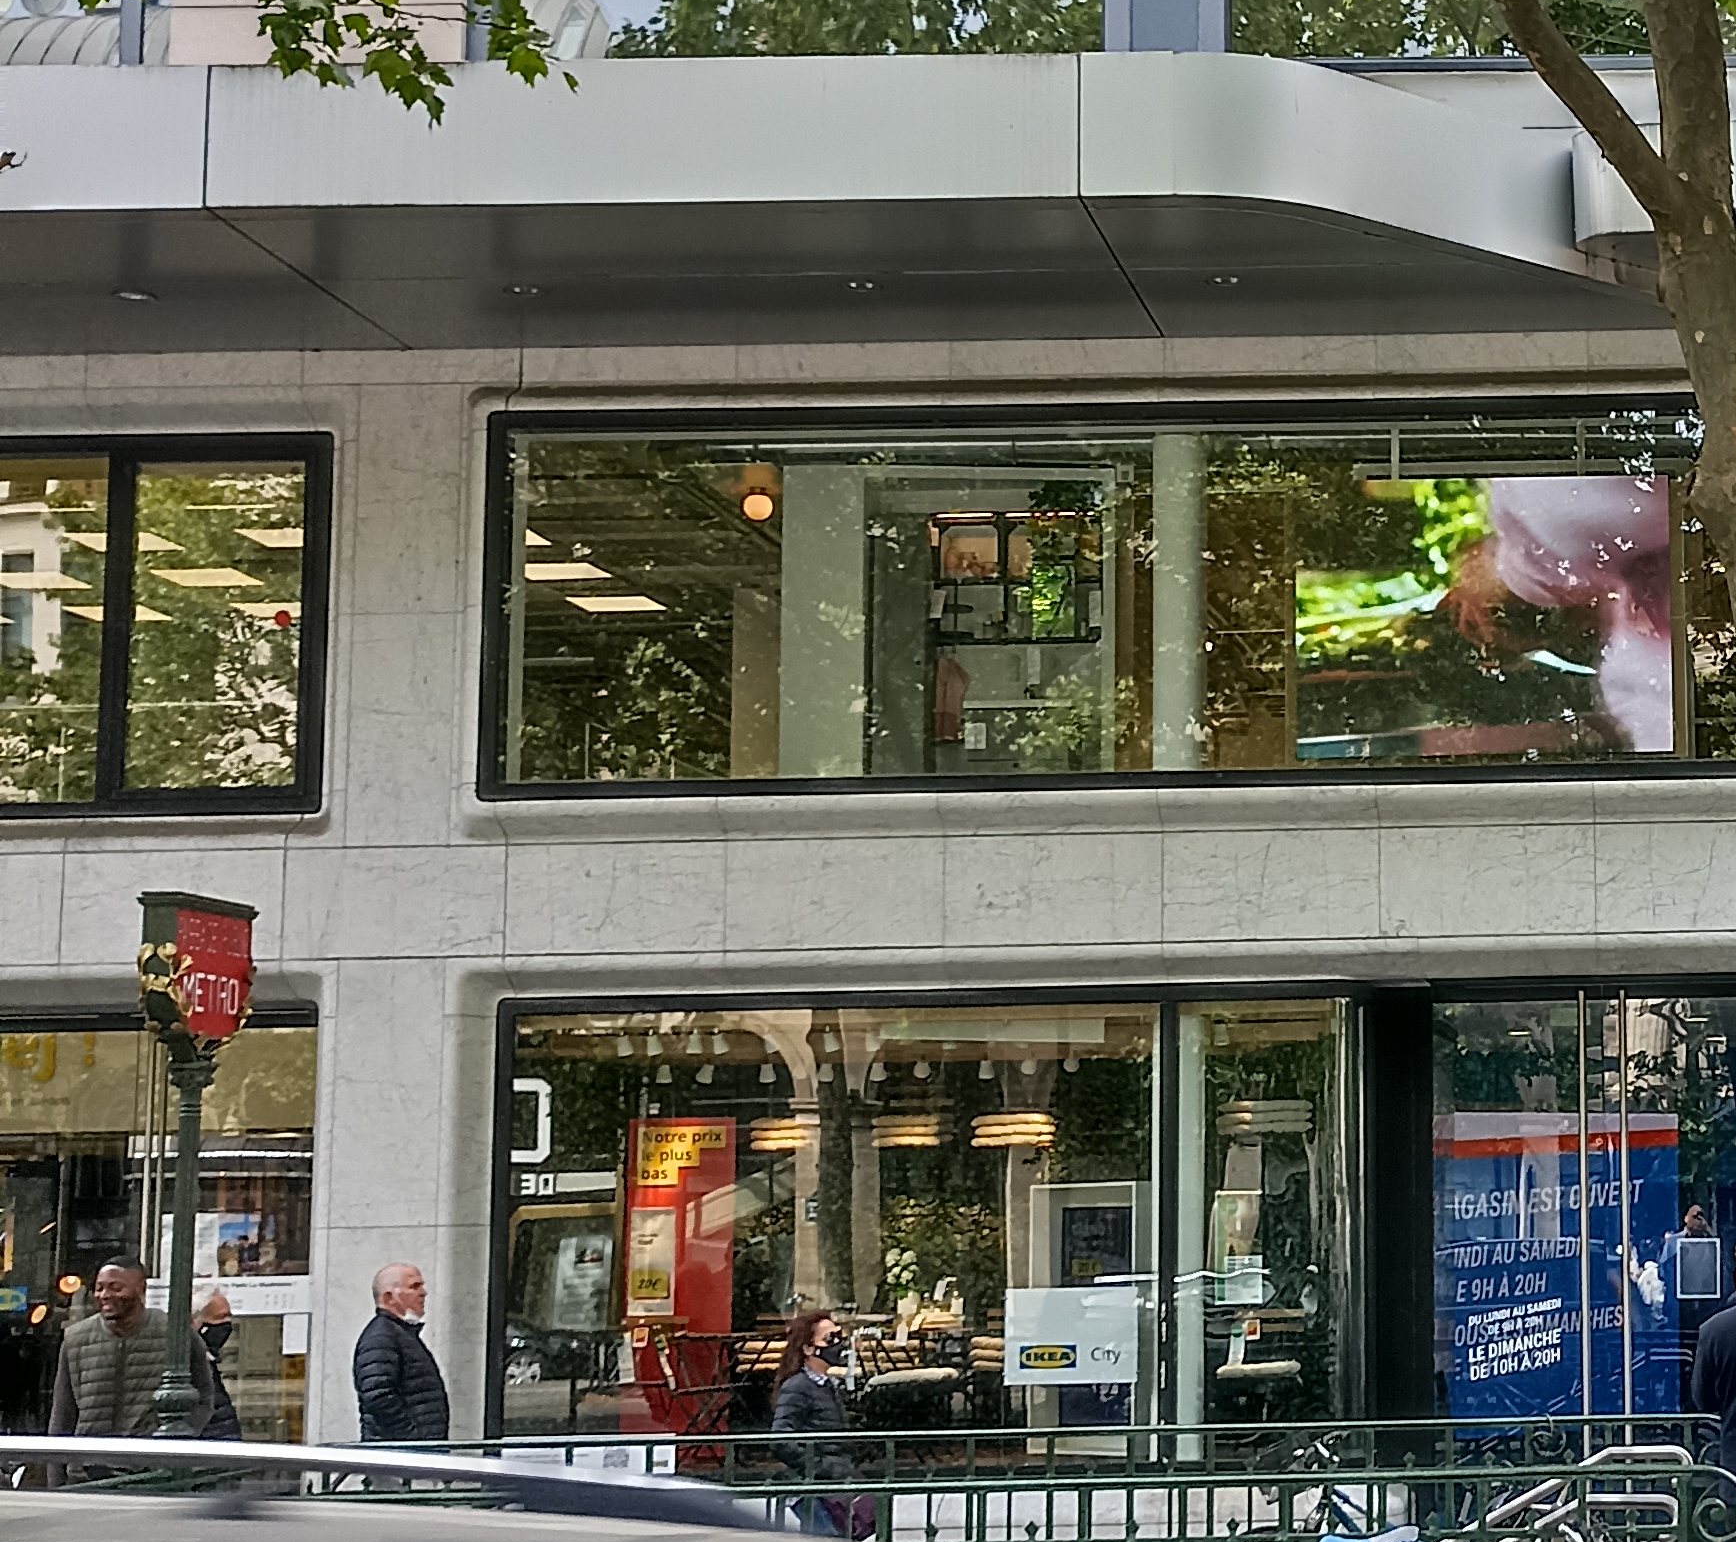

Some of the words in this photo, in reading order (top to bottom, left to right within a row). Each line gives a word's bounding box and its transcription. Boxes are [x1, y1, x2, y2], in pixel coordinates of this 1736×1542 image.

[643, 1131, 687, 1143] Notre
[692, 1129, 722, 1146] prix
[642, 1150, 654, 1162] le
[660, 1148, 692, 1165] plus
[641, 1166, 668, 1180] bas
[1492, 1242, 1515, 1265] AU
[1519, 1238, 1581, 1263] SAMEDI
[1471, 1277, 1494, 1301] 9H
[1497, 1271, 1510, 1298] À
[1513, 1271, 1547, 1297] 20H
[1025, 1351, 1072, 1362] IKEA
[1090, 1346, 1121, 1365] City
[1468, 1345, 1486, 1363] LE
[1488, 1328, 1562, 1357] DIMANCHE
[1470, 1363, 1490, 1381] DE
[1492, 1356, 1519, 1376] 10H
[1534, 1347, 1561, 1368] 20H
